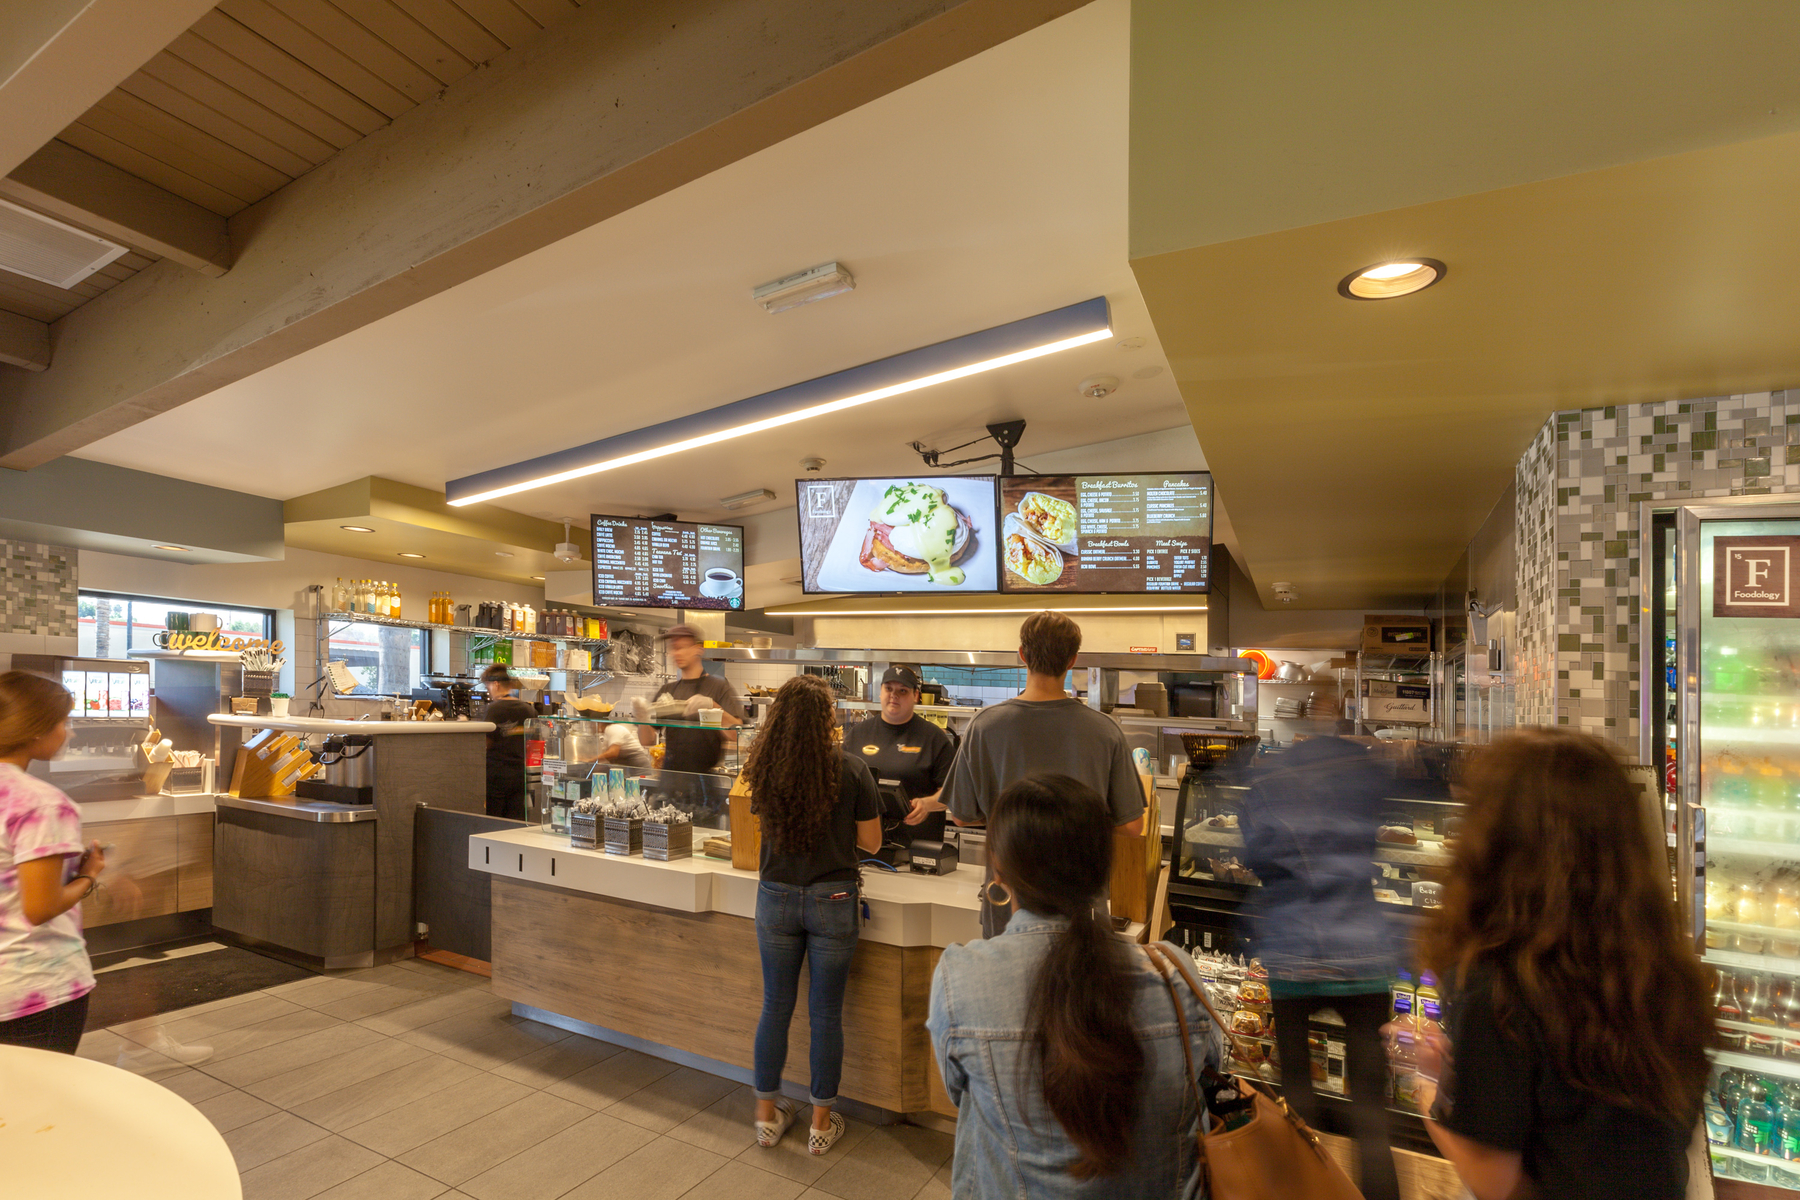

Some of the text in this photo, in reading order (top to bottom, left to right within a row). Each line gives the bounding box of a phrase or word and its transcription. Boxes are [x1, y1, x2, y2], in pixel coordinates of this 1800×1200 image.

[1081, 481, 1111, 490] Breakfast
[1163, 480, 1189, 488] Pancakes
[816, 493, 826, 508] F
[713, 528, 733, 536] Beverages
[1087, 540, 1113, 548] Breakfast
[1745, 559, 1770, 587] F
[1734, 591, 1780, 600] Foodology
[168, 627, 286, 655] welcome
[1419, 886, 1436, 895] Bear
